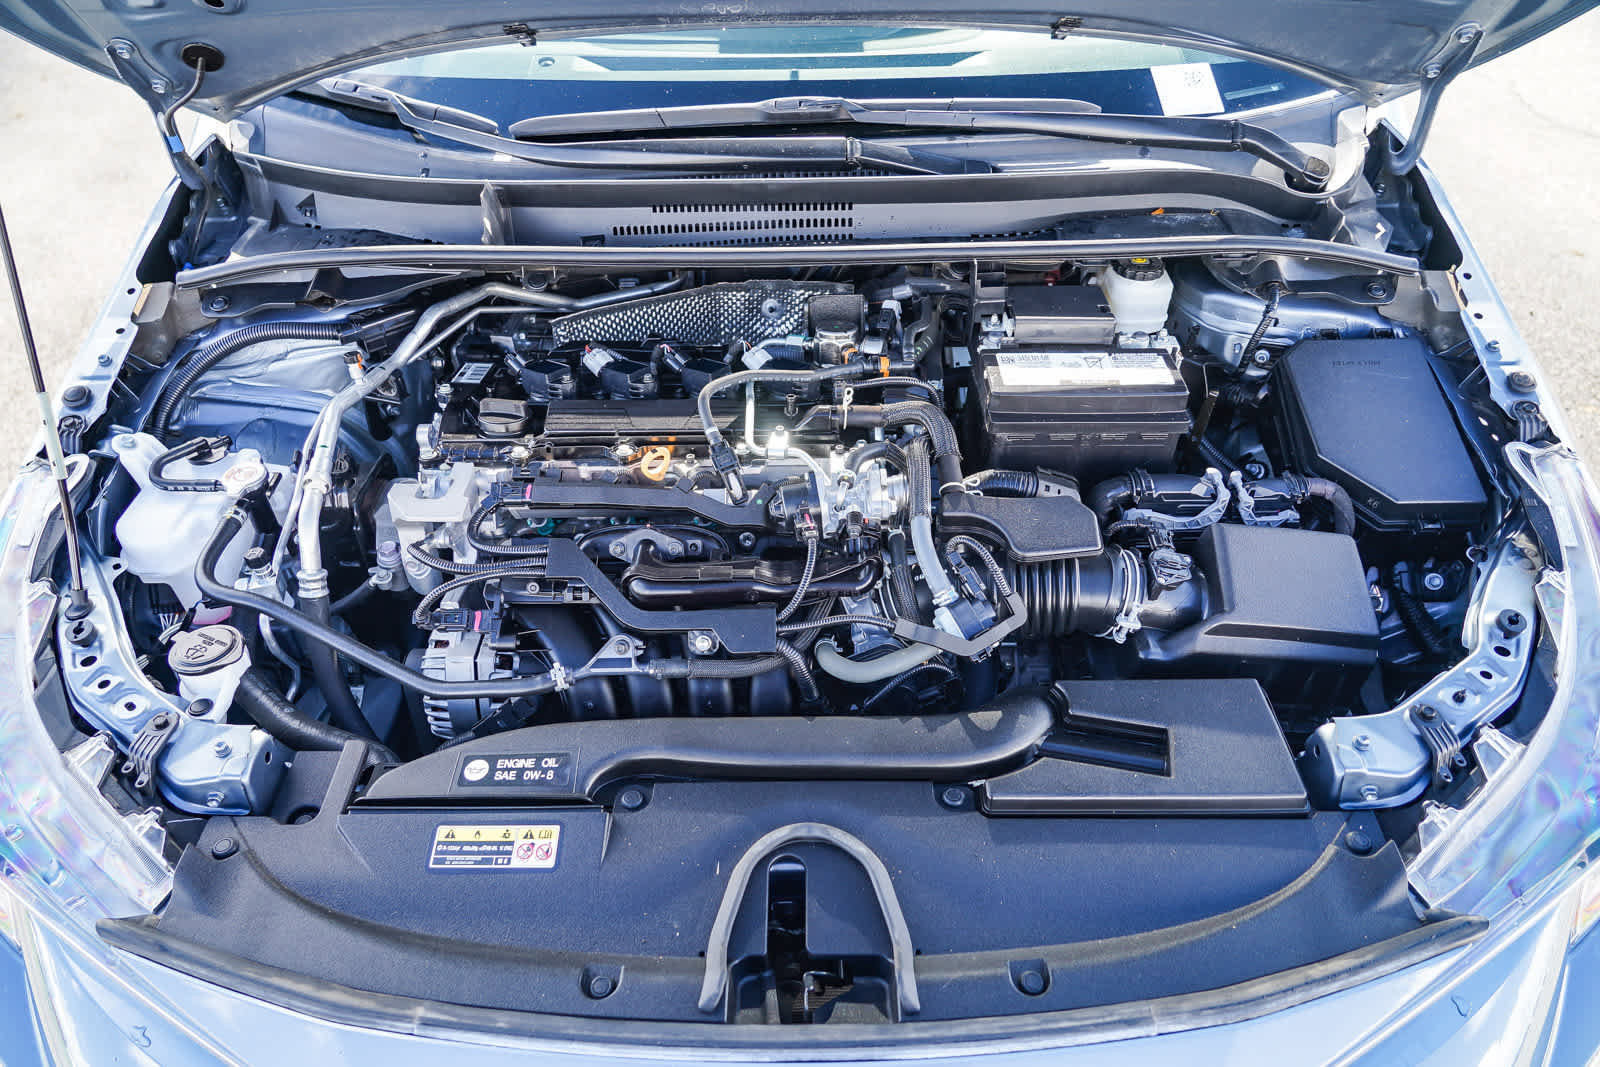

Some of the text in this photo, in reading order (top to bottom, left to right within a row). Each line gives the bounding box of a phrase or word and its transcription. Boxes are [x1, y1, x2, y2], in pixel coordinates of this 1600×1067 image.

[496, 757, 559, 769] ENGINE OIL
[493, 770, 554, 780] SAE 0W-8
